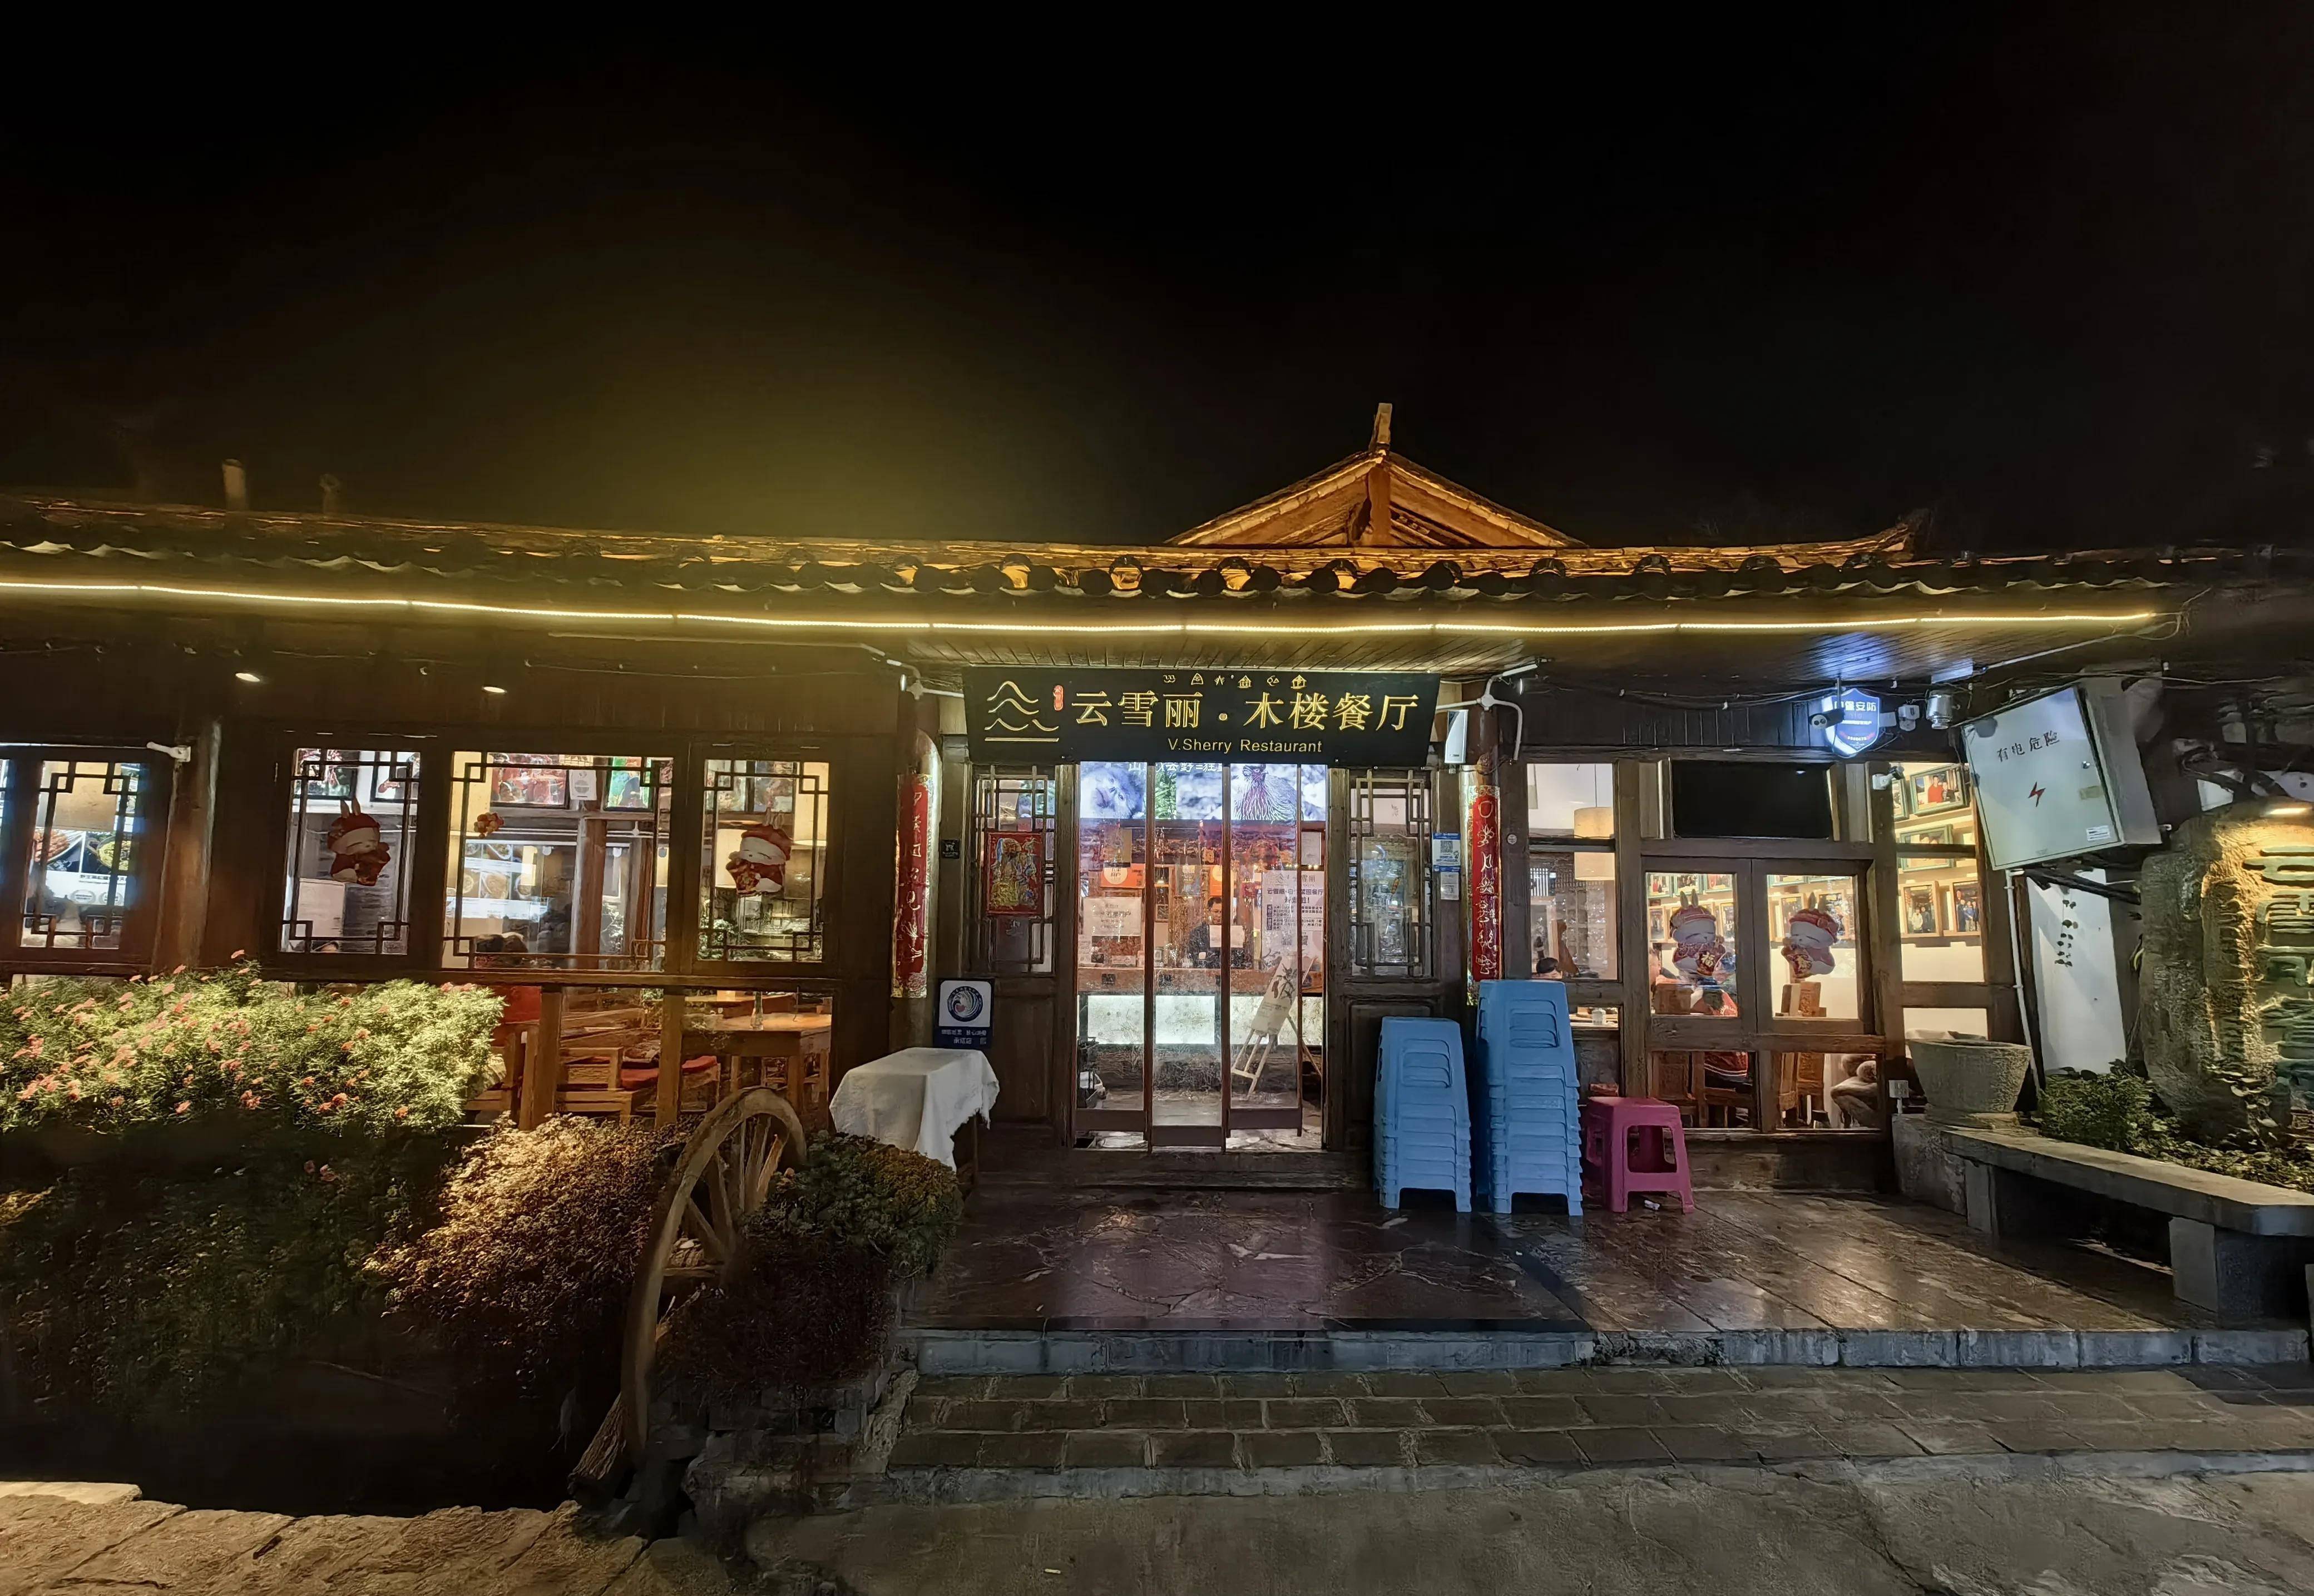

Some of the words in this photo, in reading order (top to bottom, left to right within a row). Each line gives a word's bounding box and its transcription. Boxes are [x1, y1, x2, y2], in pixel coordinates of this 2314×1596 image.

[1071, 691, 1419, 732] 云雪丽·木楼餐厅
[1168, 737, 1232, 755] V.Sherry
[1240, 738, 1323, 754] Restaurant
[1996, 730, 2060, 763] 有电危险
[1700, 951, 1715, 967] 福
